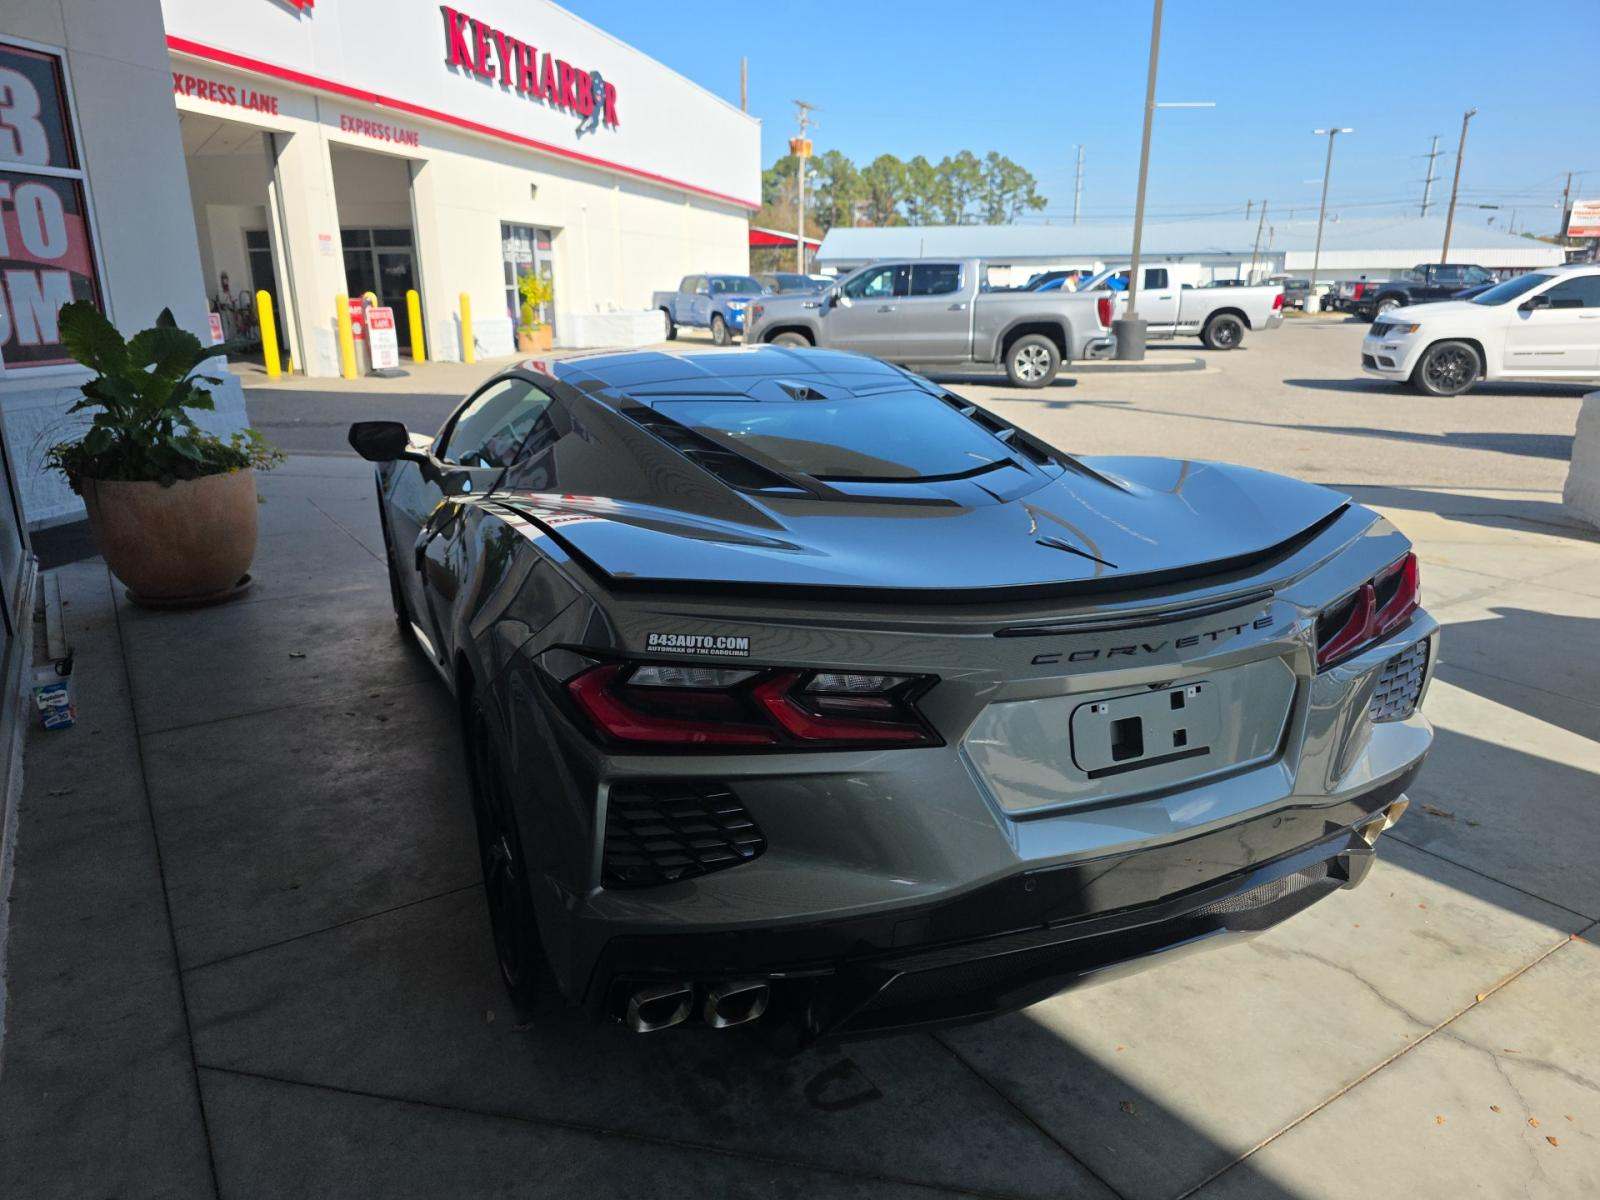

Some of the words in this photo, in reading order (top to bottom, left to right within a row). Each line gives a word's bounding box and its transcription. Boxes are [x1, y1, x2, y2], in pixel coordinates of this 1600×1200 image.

[241, 89, 279, 116] LANE
[340, 114, 390, 143] EXPRESS
[393, 128, 420, 148] LANE
[648, 633, 749, 649] 843AUTO.COM
[1030, 616, 1274, 665] CORVETTE
